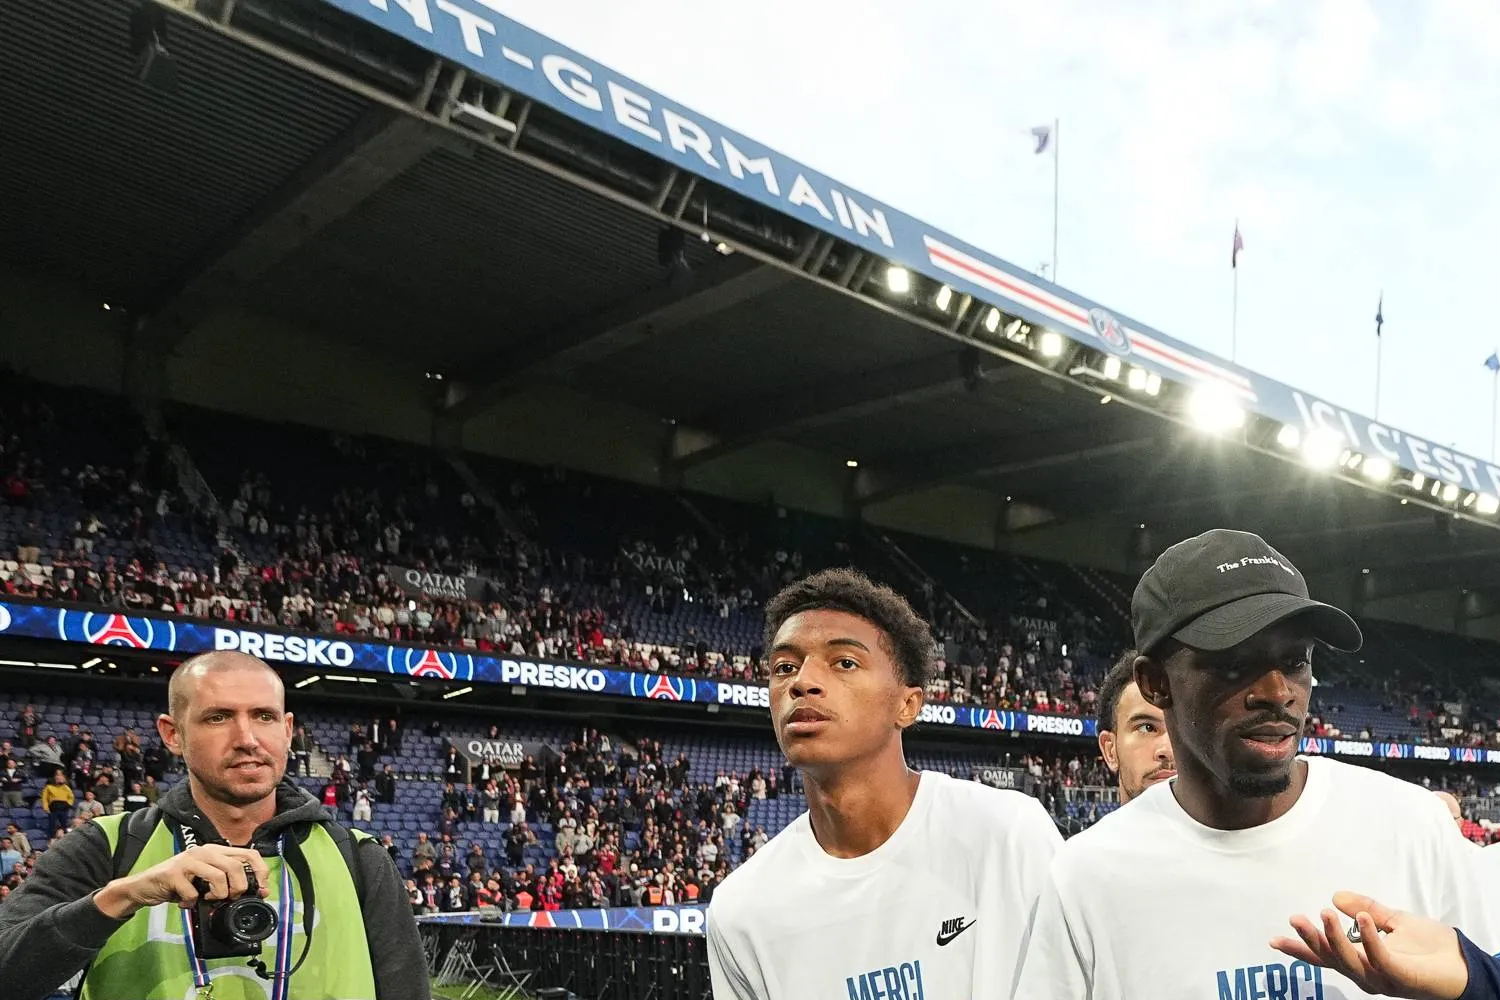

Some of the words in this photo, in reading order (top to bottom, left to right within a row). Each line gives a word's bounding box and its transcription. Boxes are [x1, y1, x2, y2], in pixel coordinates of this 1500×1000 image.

[1367, 422, 1481, 489] C'EST
[1217, 561, 1239, 573] The
[405, 569, 466, 592] QATAR
[214, 628, 355, 668] PRESKO
[501, 660, 606, 692] PRESKO
[1027, 714, 1083, 736] PRESKO
[468, 740, 523, 758] QATAR
